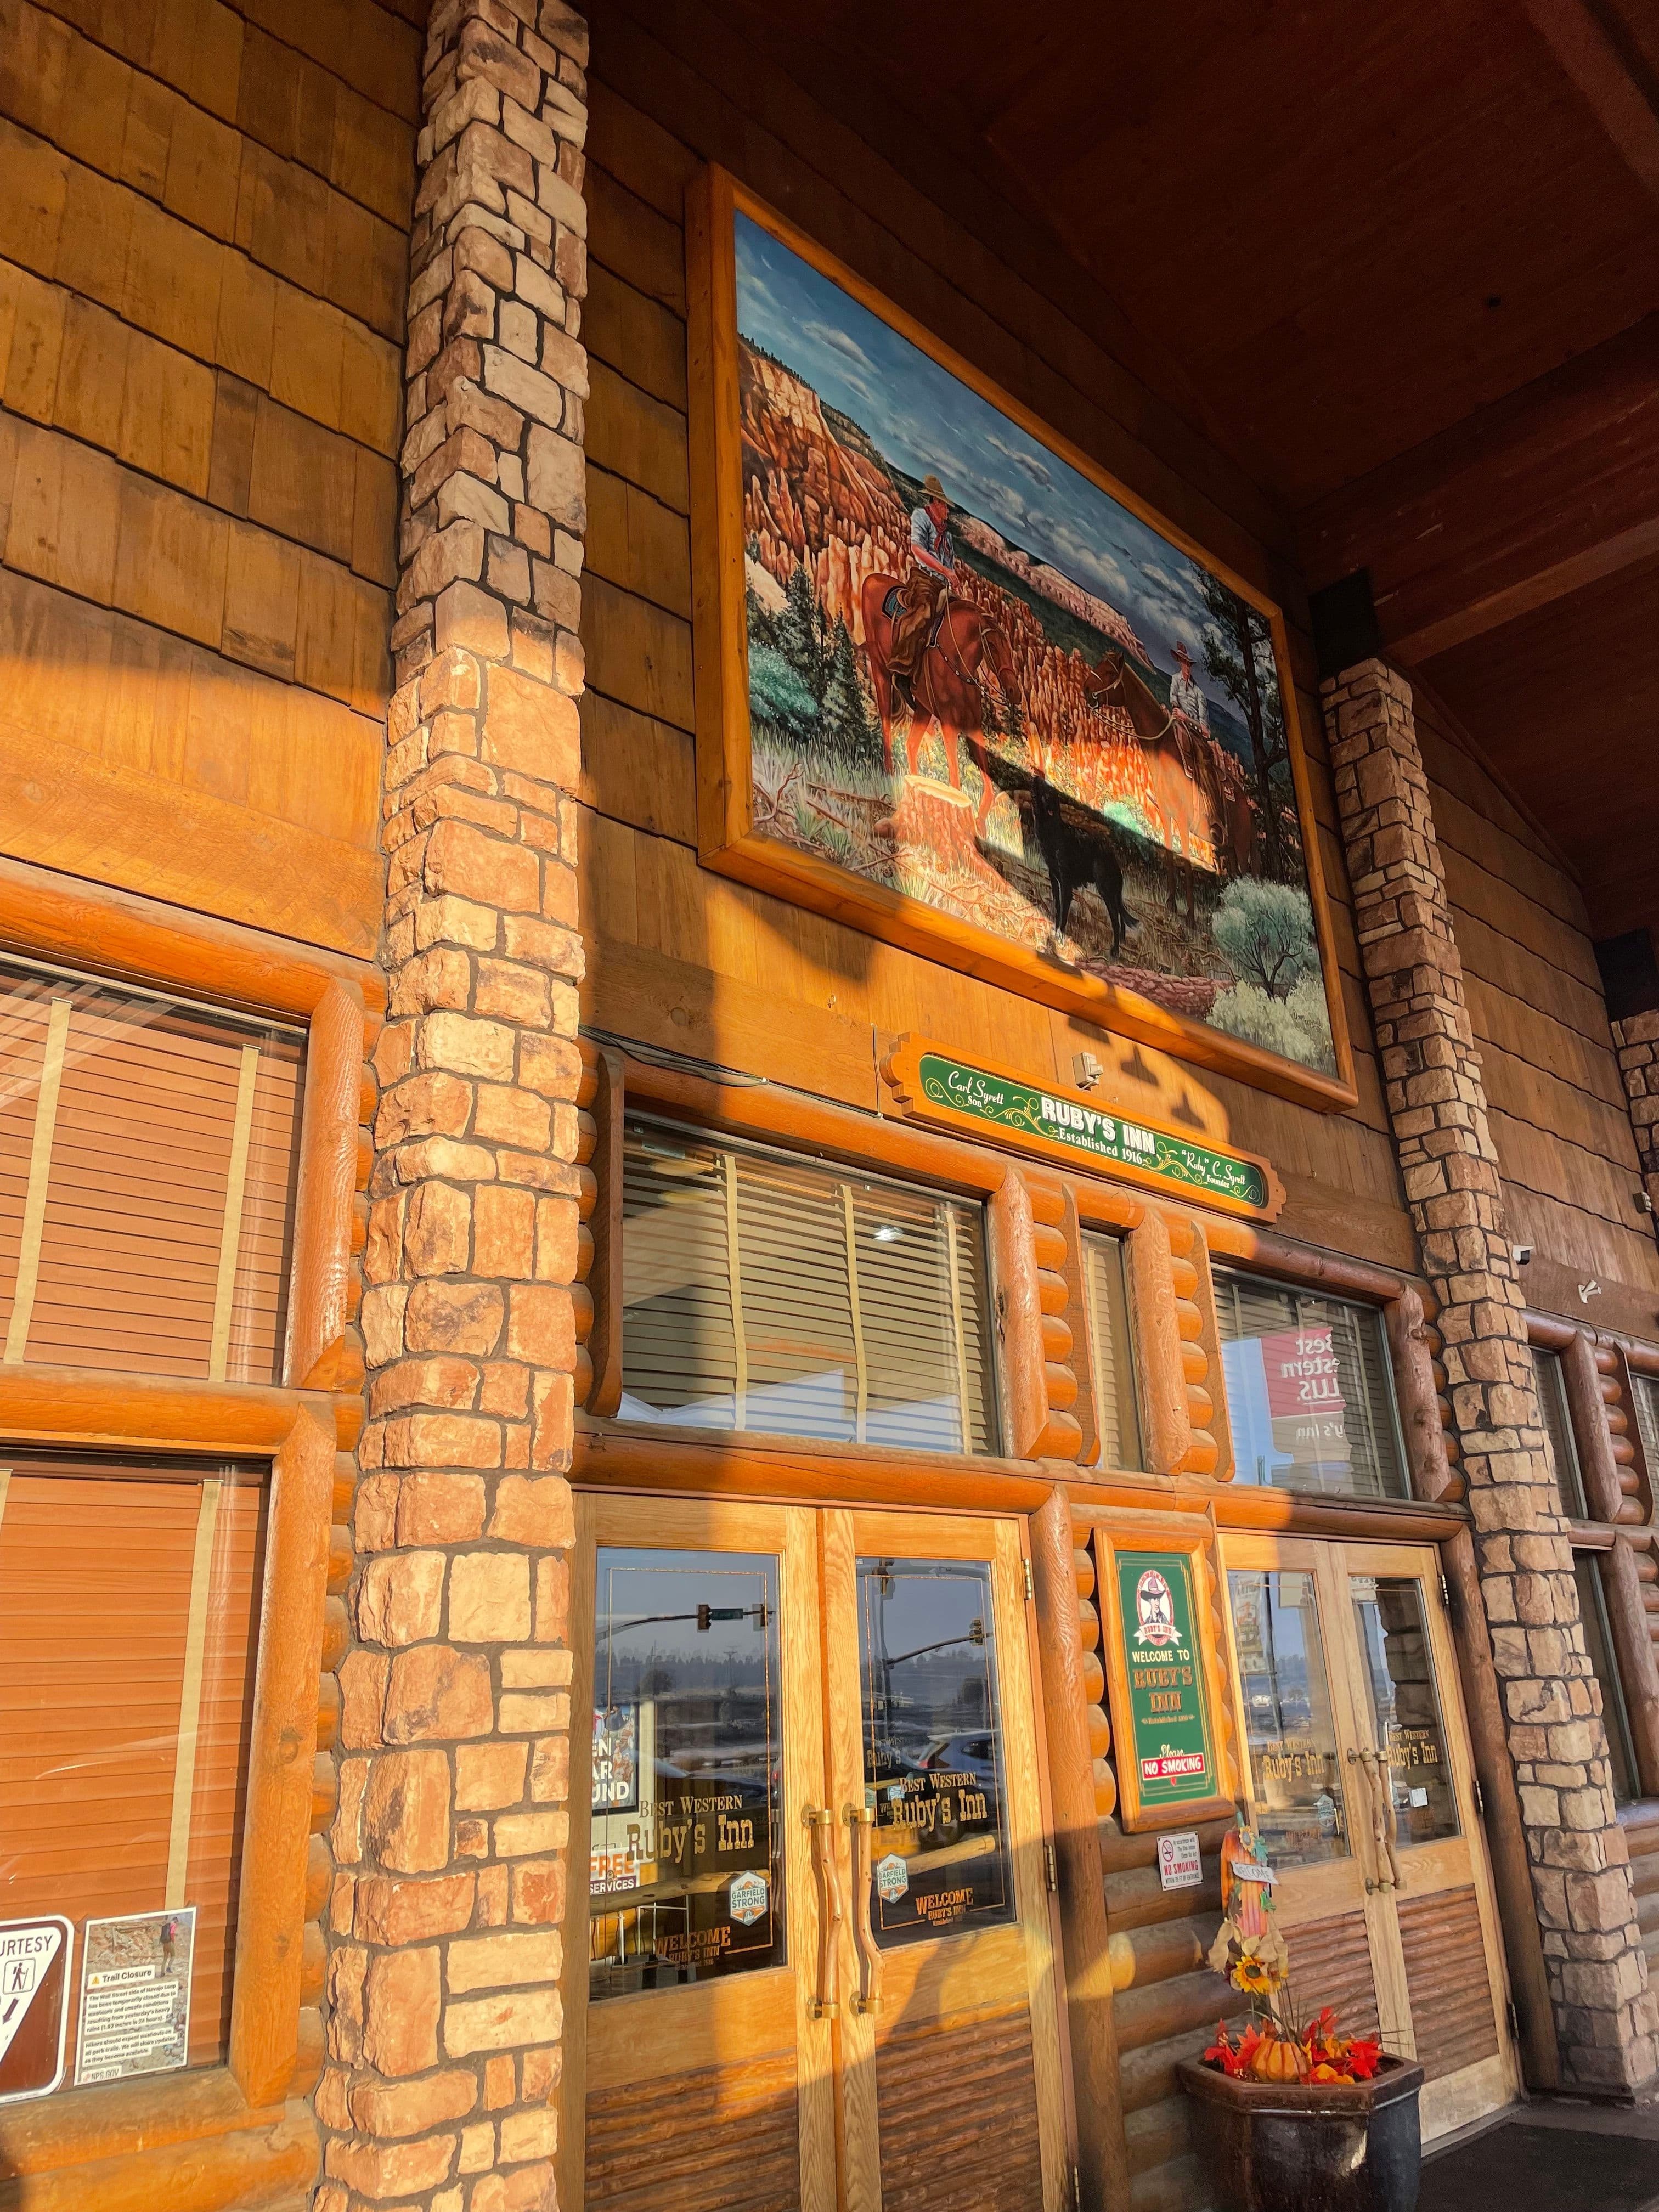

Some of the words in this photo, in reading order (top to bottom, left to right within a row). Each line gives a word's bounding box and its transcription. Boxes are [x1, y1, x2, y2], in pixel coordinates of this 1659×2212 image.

[948, 1071, 973, 1094] Carl
[973, 1080, 1003, 1105] Syrett
[968, 1095, 982, 1108] Son
[1041, 1096, 1117, 1142] RUBY'S
[1122, 1124, 1156, 1155] INN
[1059, 1127, 1118, 1156] Established
[1122, 1148, 1143, 1165] 1916
[1207, 1175, 1230, 1188] Founder
[1223, 1164, 1245, 1186] Syrett
[1132, 1650, 1173, 1663] WELCOME
[1177, 1649, 1190, 1661] TO
[1133, 1666, 1193, 1690] RUBY'S
[1149, 1691, 1182, 1713] INN
[1159, 1743, 1185, 1758] Please
[1386, 1742, 1419, 1770] Ruby's
[1144, 1761, 1159, 1775] NO
[1161, 1756, 1201, 1774] SMOKING
[1262, 1752, 1302, 1782] Ruby's
[899, 1777, 926, 1793] BEST
[929, 1771, 977, 1789] WESTERN
[640, 1801, 674, 1818] BEST
[680, 1795, 743, 1814] WESTERN
[891, 1792, 951, 1832] Ruby's
[958, 1788, 988, 1821] Inn
[627, 1818, 706, 1864] Ruby's
[718, 1814, 754, 1852] Inn
[1164, 1864, 1172, 1876] NO
[1173, 1860, 1198, 1874] SMOKING
[1235, 1866, 1272, 1881] WELCOME
[732, 1888, 765, 1899] GARFIELD
[732, 1895, 765, 1908] STRONG
[915, 1887, 974, 1915] WELCOME
[928, 1906, 952, 1921] RUBY'S
[953, 1904, 966, 1915] INN
[655, 1926, 731, 1958] WELCOME
[703, 1945, 720, 1958] INN
[102, 1973, 120, 1983] Trail
[121, 1969, 152, 1980] Closure
